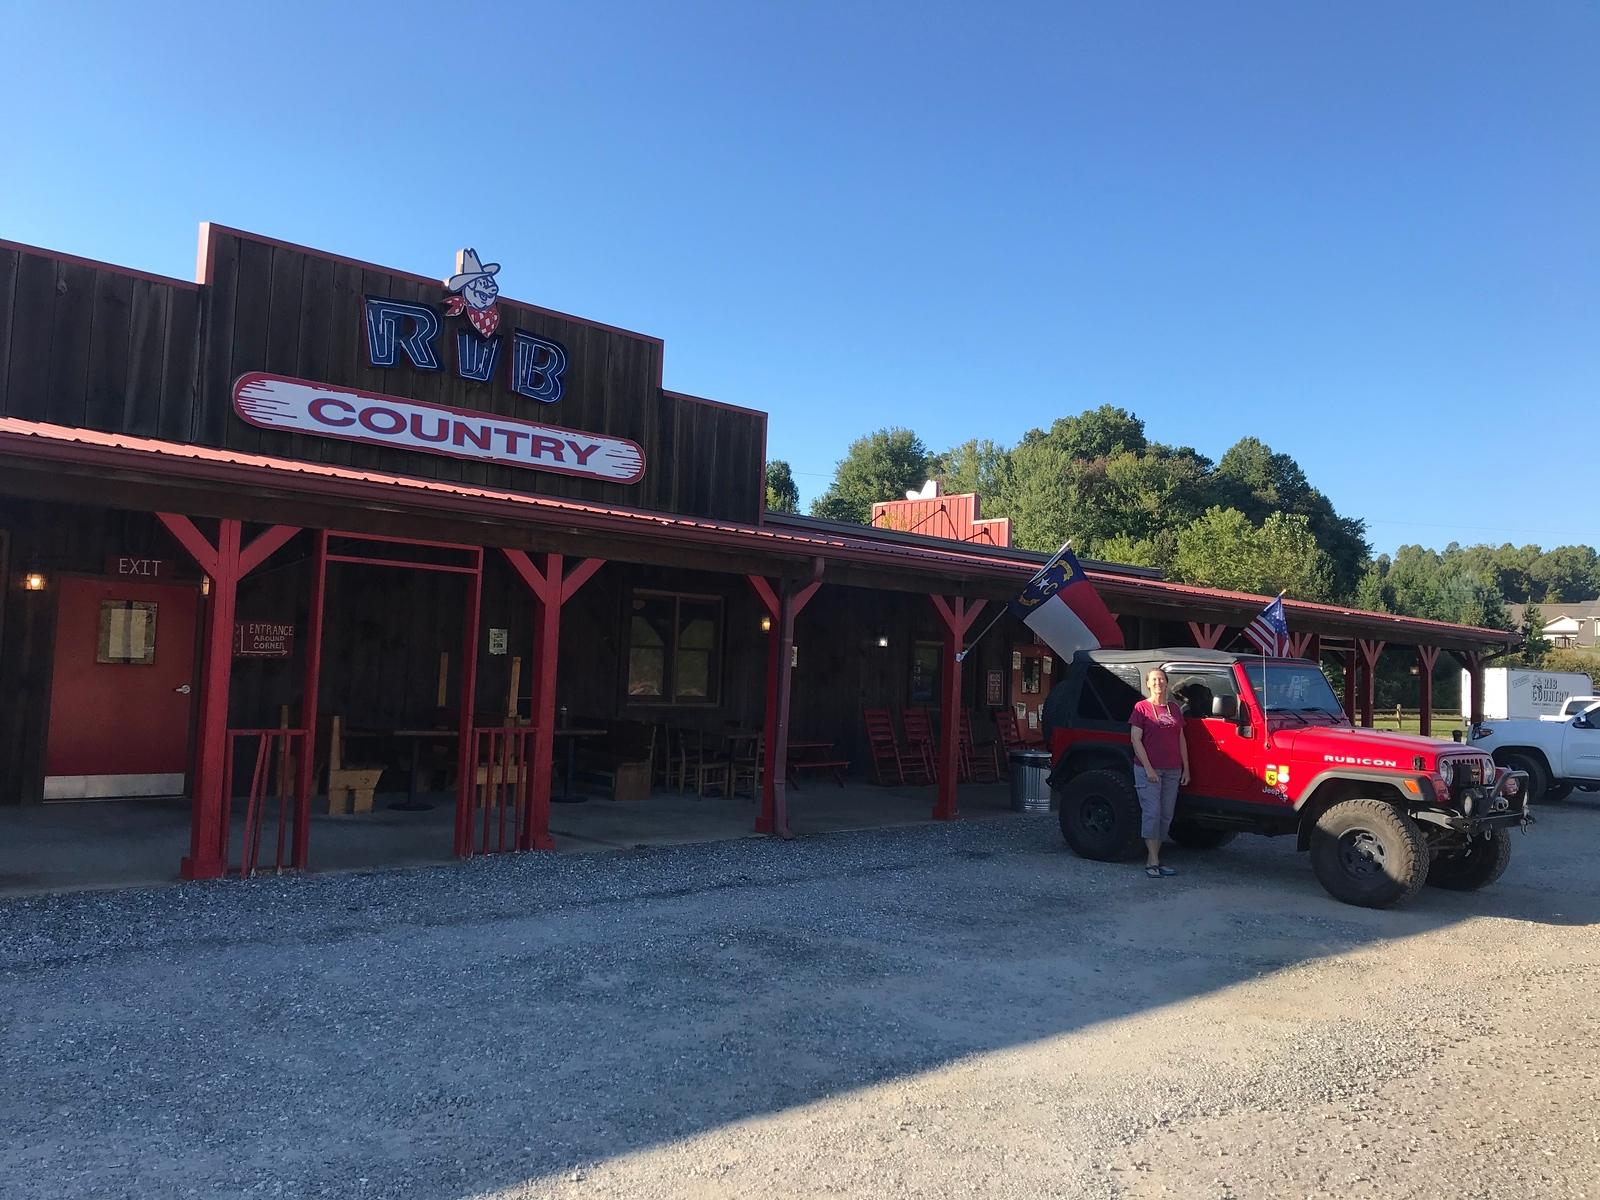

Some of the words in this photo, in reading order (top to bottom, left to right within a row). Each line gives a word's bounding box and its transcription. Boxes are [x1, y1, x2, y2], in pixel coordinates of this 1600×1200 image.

[307, 398, 601, 466] COUNTRY
[119, 558, 162, 577] EXIT
[249, 623, 295, 636] ENTRANCE
[253, 642, 285, 650] CORNER
[1543, 678, 1558, 690] RIB
[1324, 754, 1397, 768] RUBICON
[1262, 786, 1280, 796] Jeep
